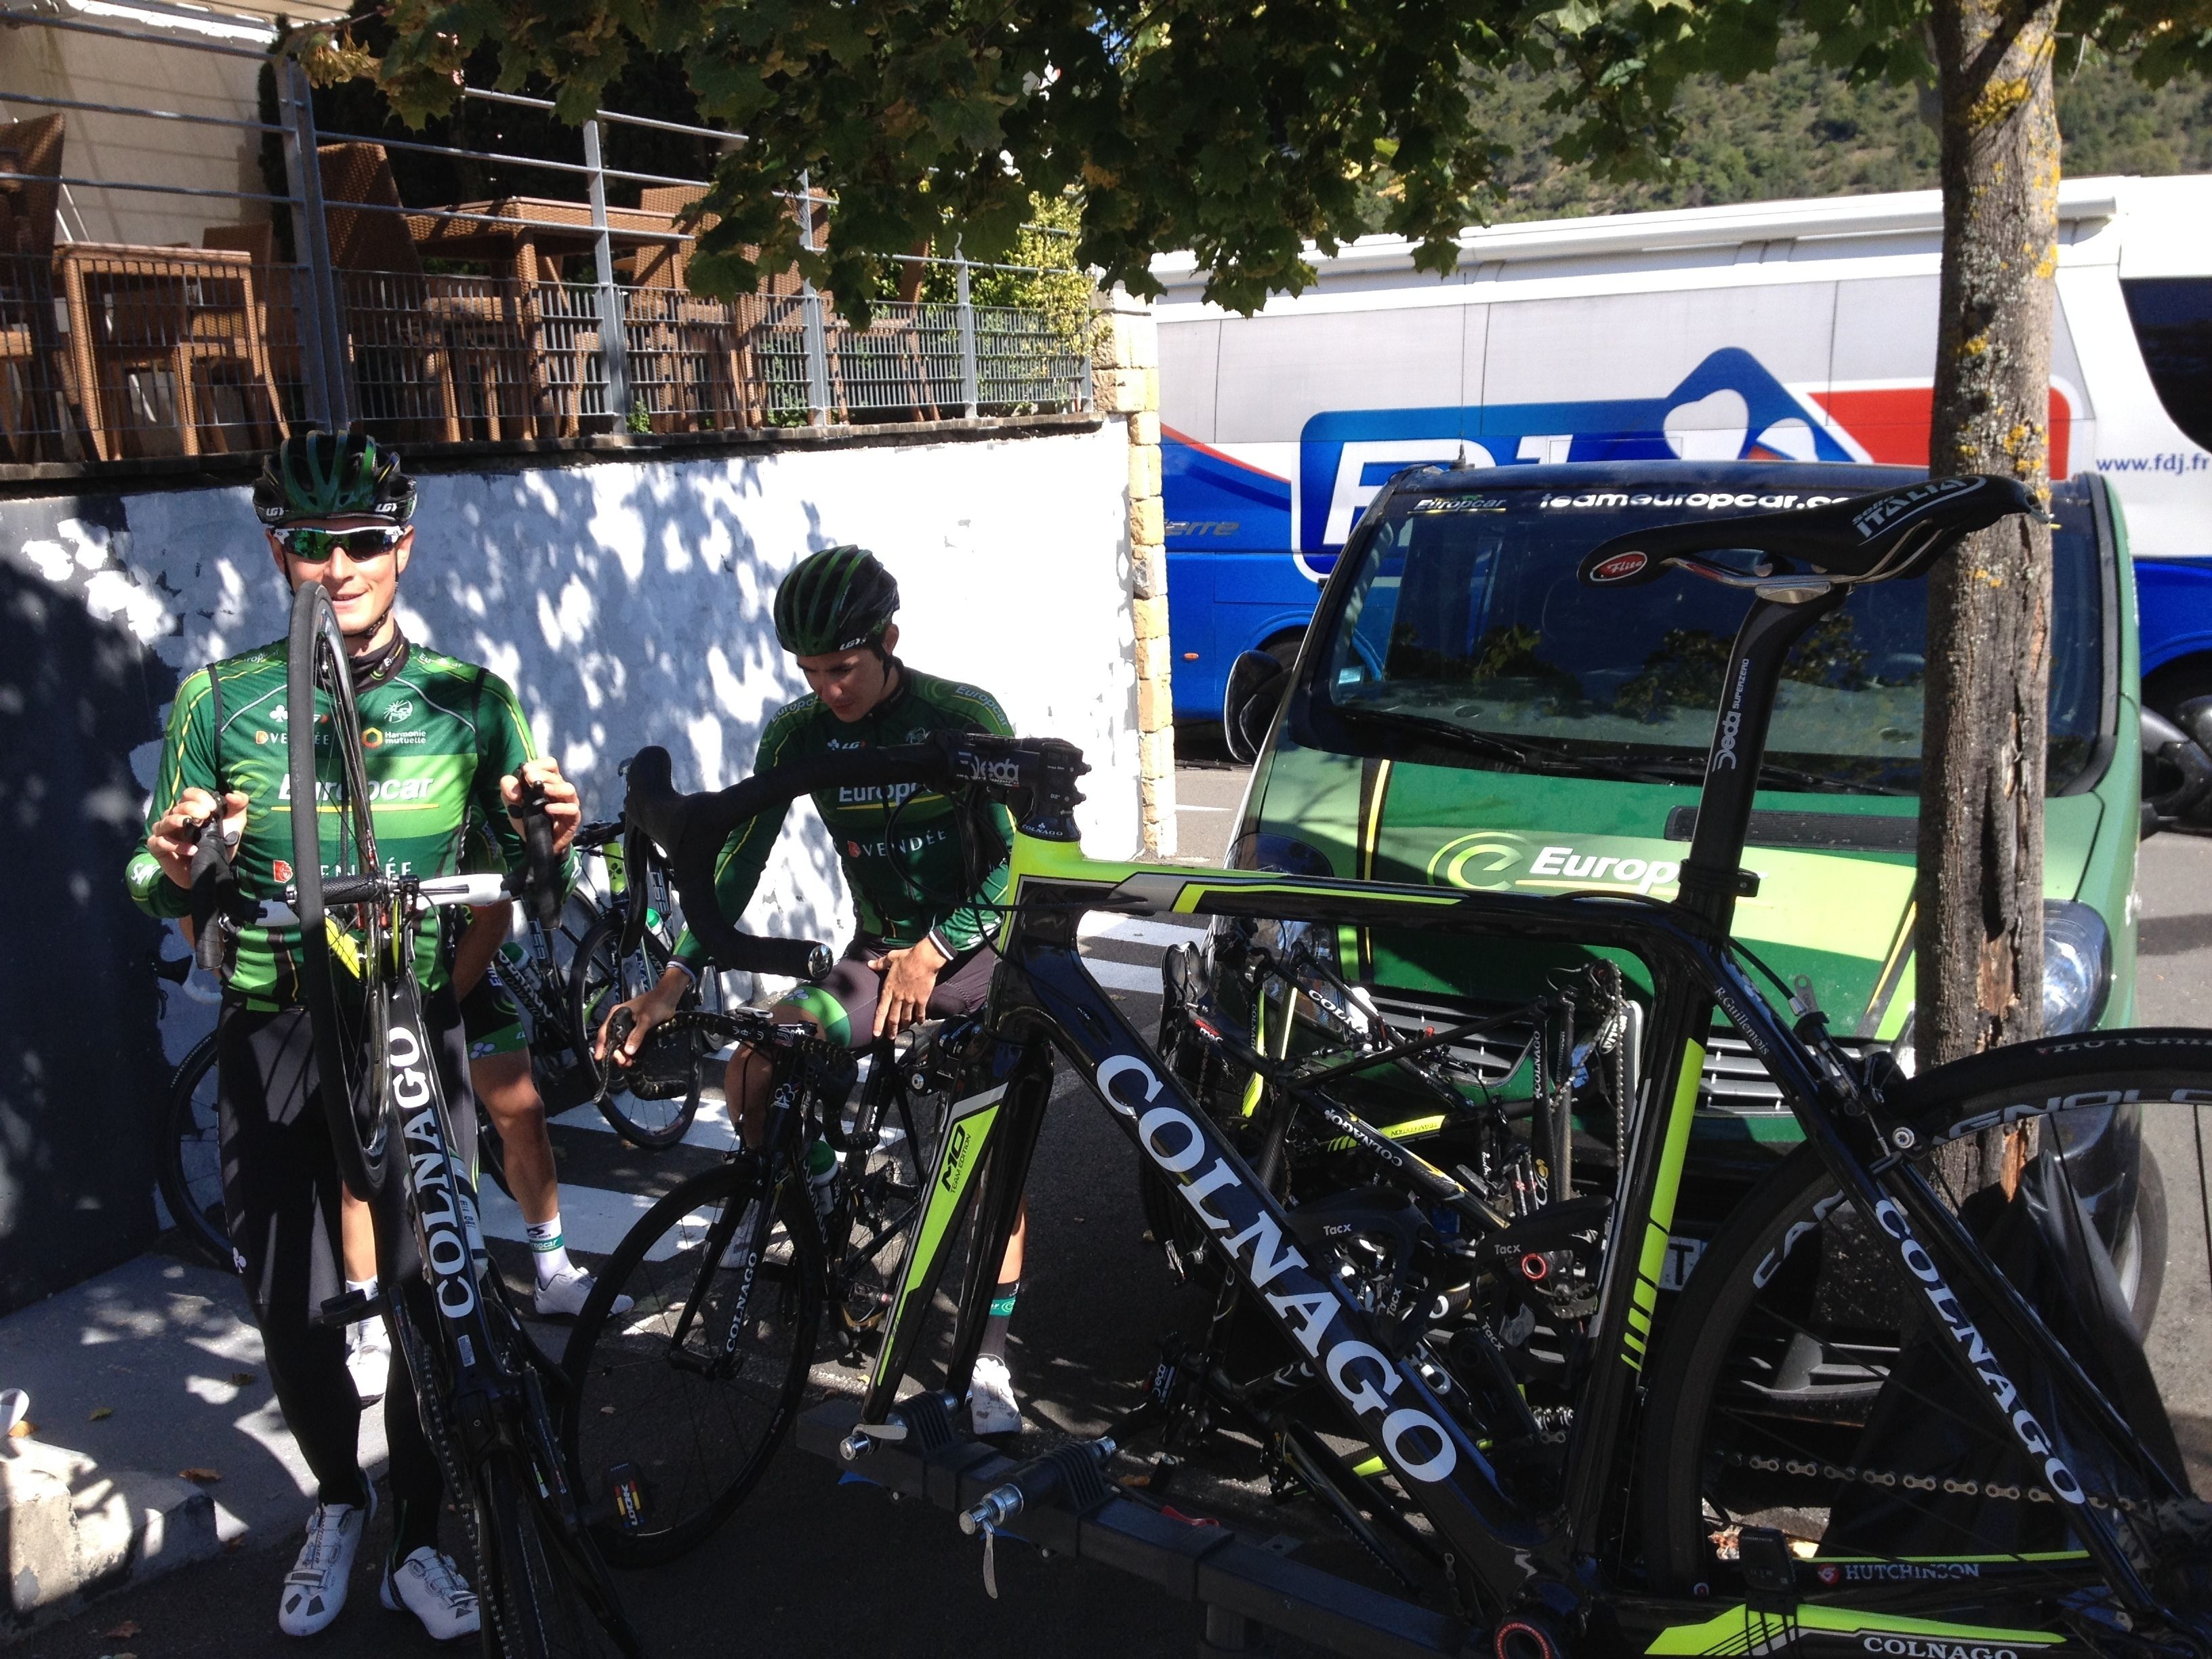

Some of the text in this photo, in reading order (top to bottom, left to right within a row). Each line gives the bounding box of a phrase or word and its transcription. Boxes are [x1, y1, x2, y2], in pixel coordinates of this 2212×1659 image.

[2095, 453, 2210, 476] www.fdj.fr
[1413, 498, 1508, 512] Europcar
[1539, 491, 1851, 510] teameuropcar.c
[1857, 479, 1967, 538] ITALIA
[1606, 558, 1645, 575] Flite
[1732, 658, 1750, 710] SUPERZERO
[955, 685, 1008, 727] Europcar
[384, 730, 427, 738] Harmonie
[1021, 823, 1063, 836] COLNAGO
[1530, 846, 1681, 893] Europ
[1715, 986, 1770, 1055] R.Guillemois
[1533, 1030, 1541, 1089] COLNAGO
[1332, 1113, 1404, 1168] COLNAGO
[388, 1026, 475, 1319] COLNAGO
[949, 1133, 972, 1193] TEAM EDITION
[1324, 1223, 1352, 1236] Tacx
[1494, 1243, 1521, 1256] Tacx
[1096, 1054, 1458, 1483] COLNAGO
[726, 1252, 758, 1353] COLNAGO
[1386, 1287, 1402, 1317] Tacx
[1481, 1317, 1506, 1353] Tacx
[1875, 1199, 2086, 1504] COLNAGO
[621, 1483, 638, 1526] LOOK
[1845, 1563, 1980, 1581] HUTCHINSON
[1863, 1637, 2018, 1659] COLNAGO
